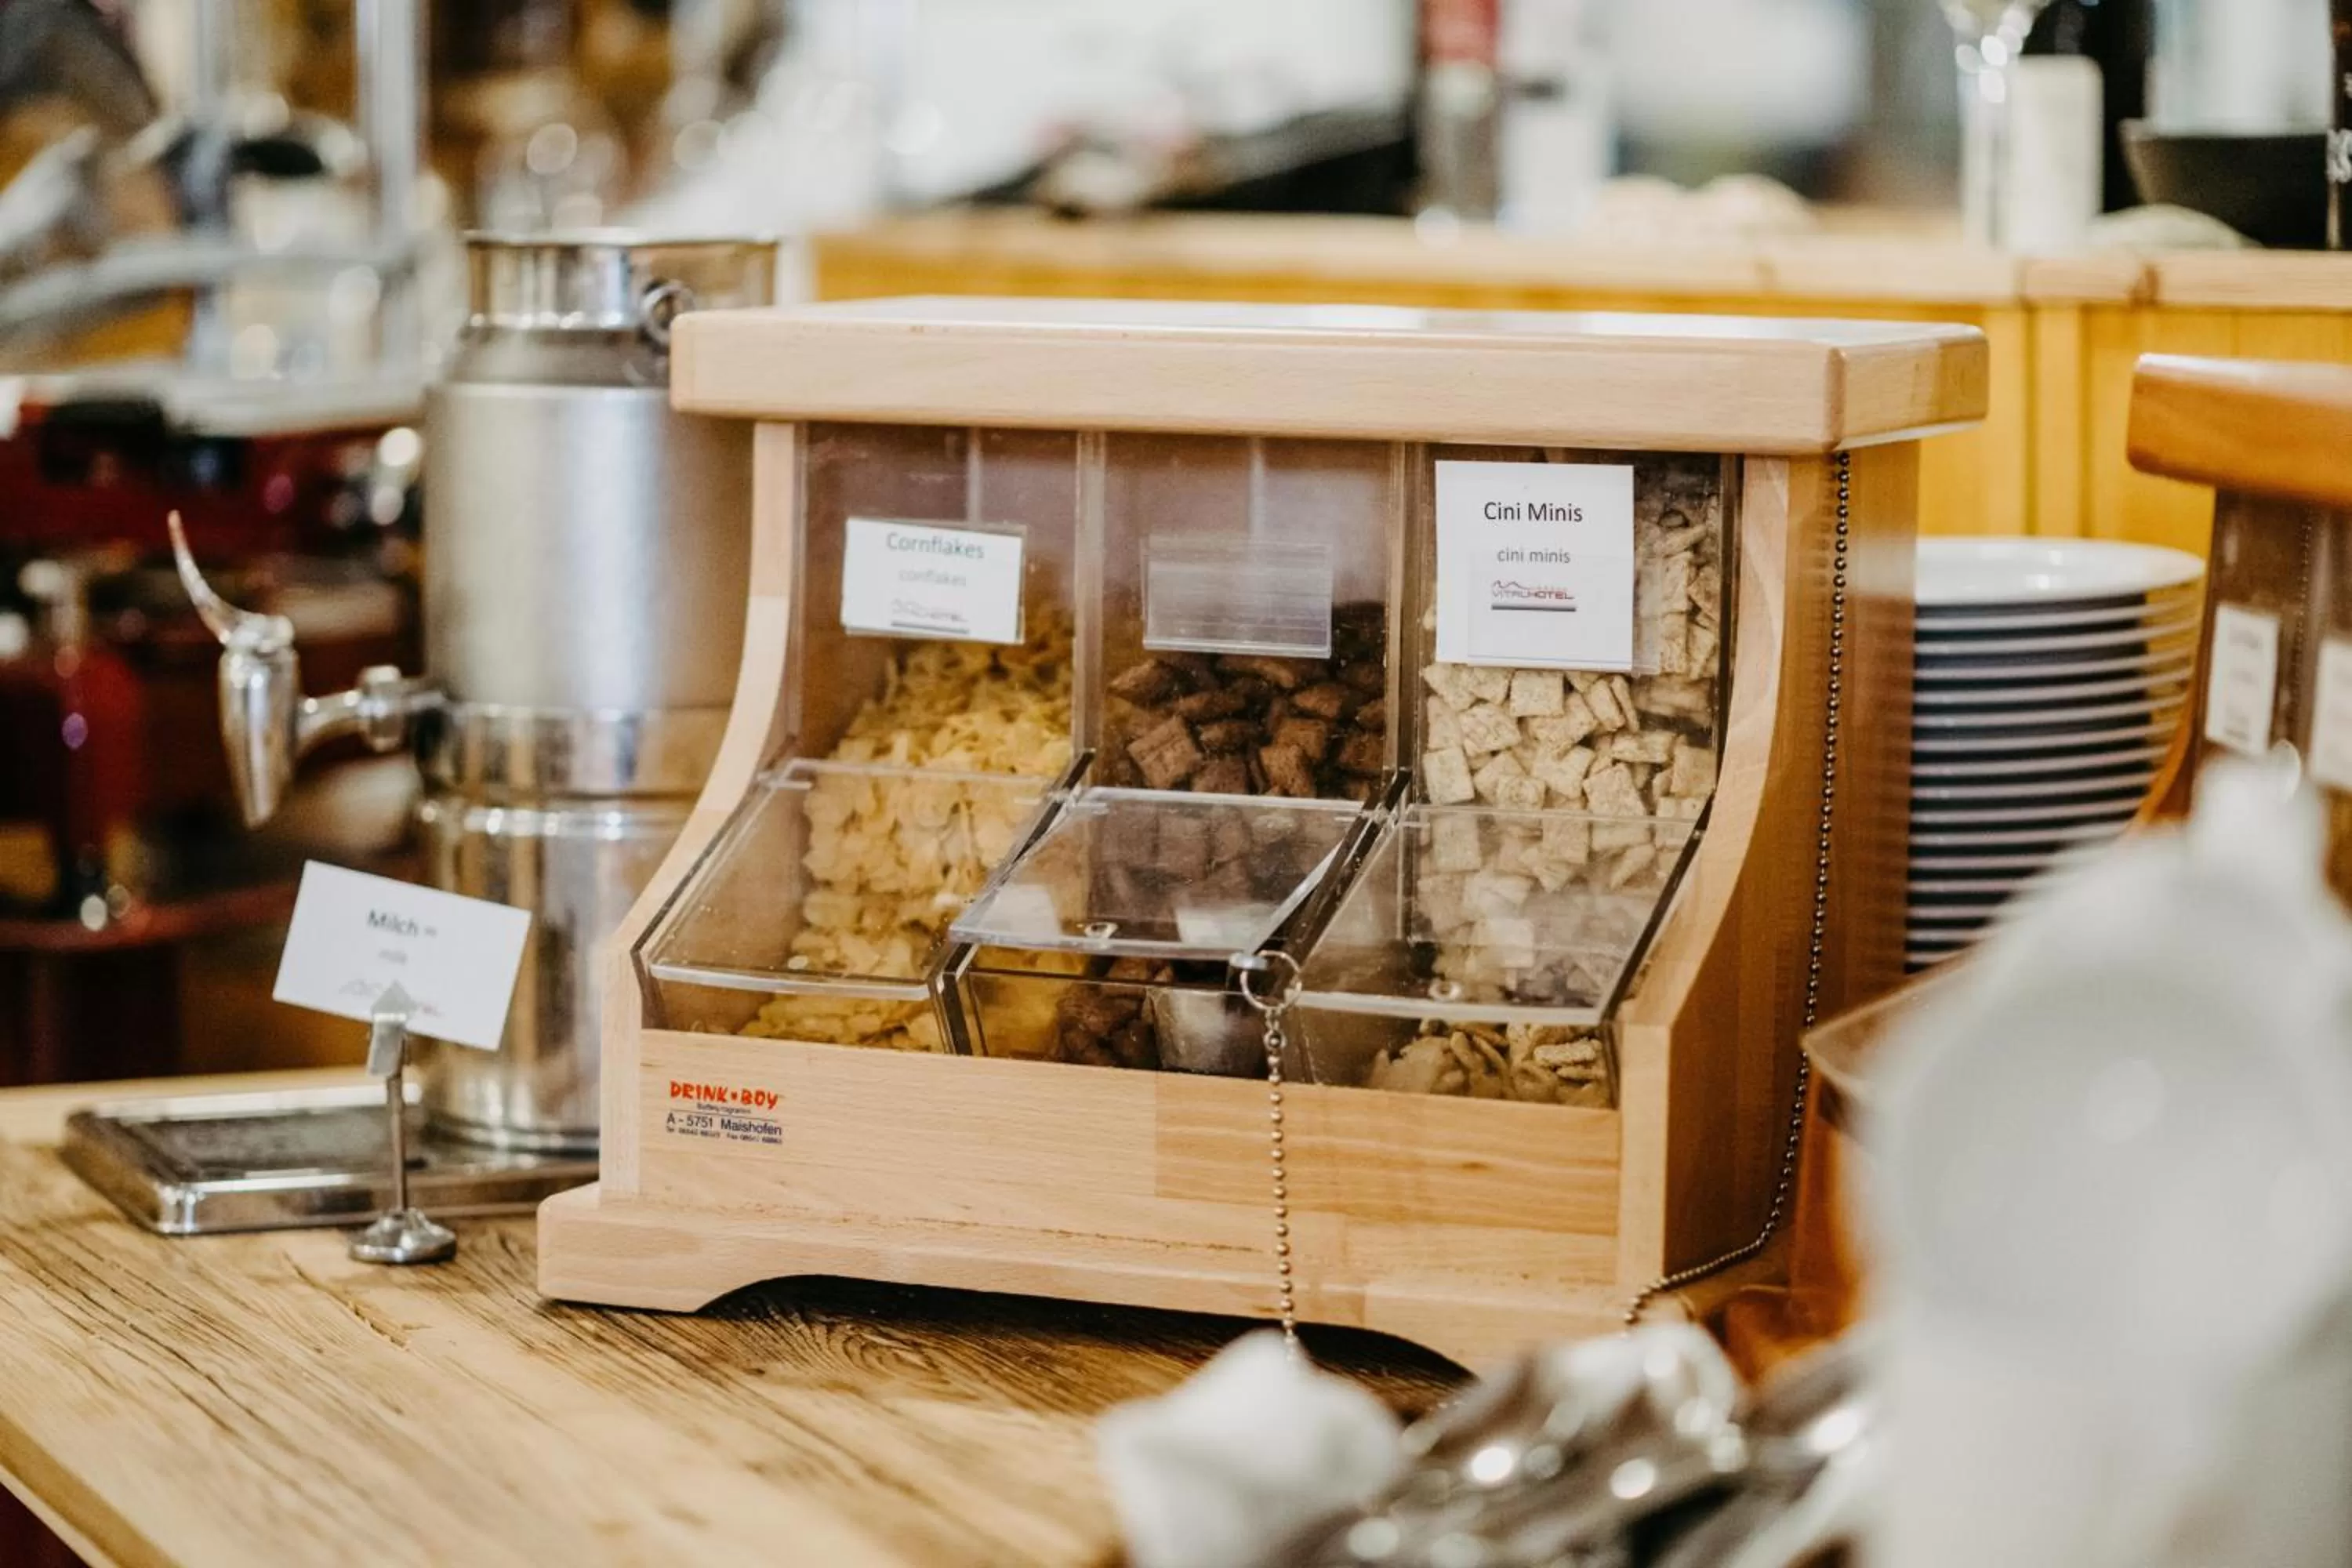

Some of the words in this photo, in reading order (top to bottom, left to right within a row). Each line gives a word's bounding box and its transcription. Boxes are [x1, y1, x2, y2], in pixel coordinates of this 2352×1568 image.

[1483, 502, 1521, 521] Cini
[1528, 503, 1584, 522] Minis
[886, 532, 985, 559] Cornflakes
[1497, 546, 1524, 563] cini
[1530, 547, 1571, 564] minis
[366, 909, 419, 938] Milch
[670, 1080, 728, 1103] DRINK
[740, 1087, 779, 1110] BOY
[666, 1112, 676, 1124] A
[686, 1115, 713, 1128] 5751
[720, 1118, 782, 1136] Maishofen
